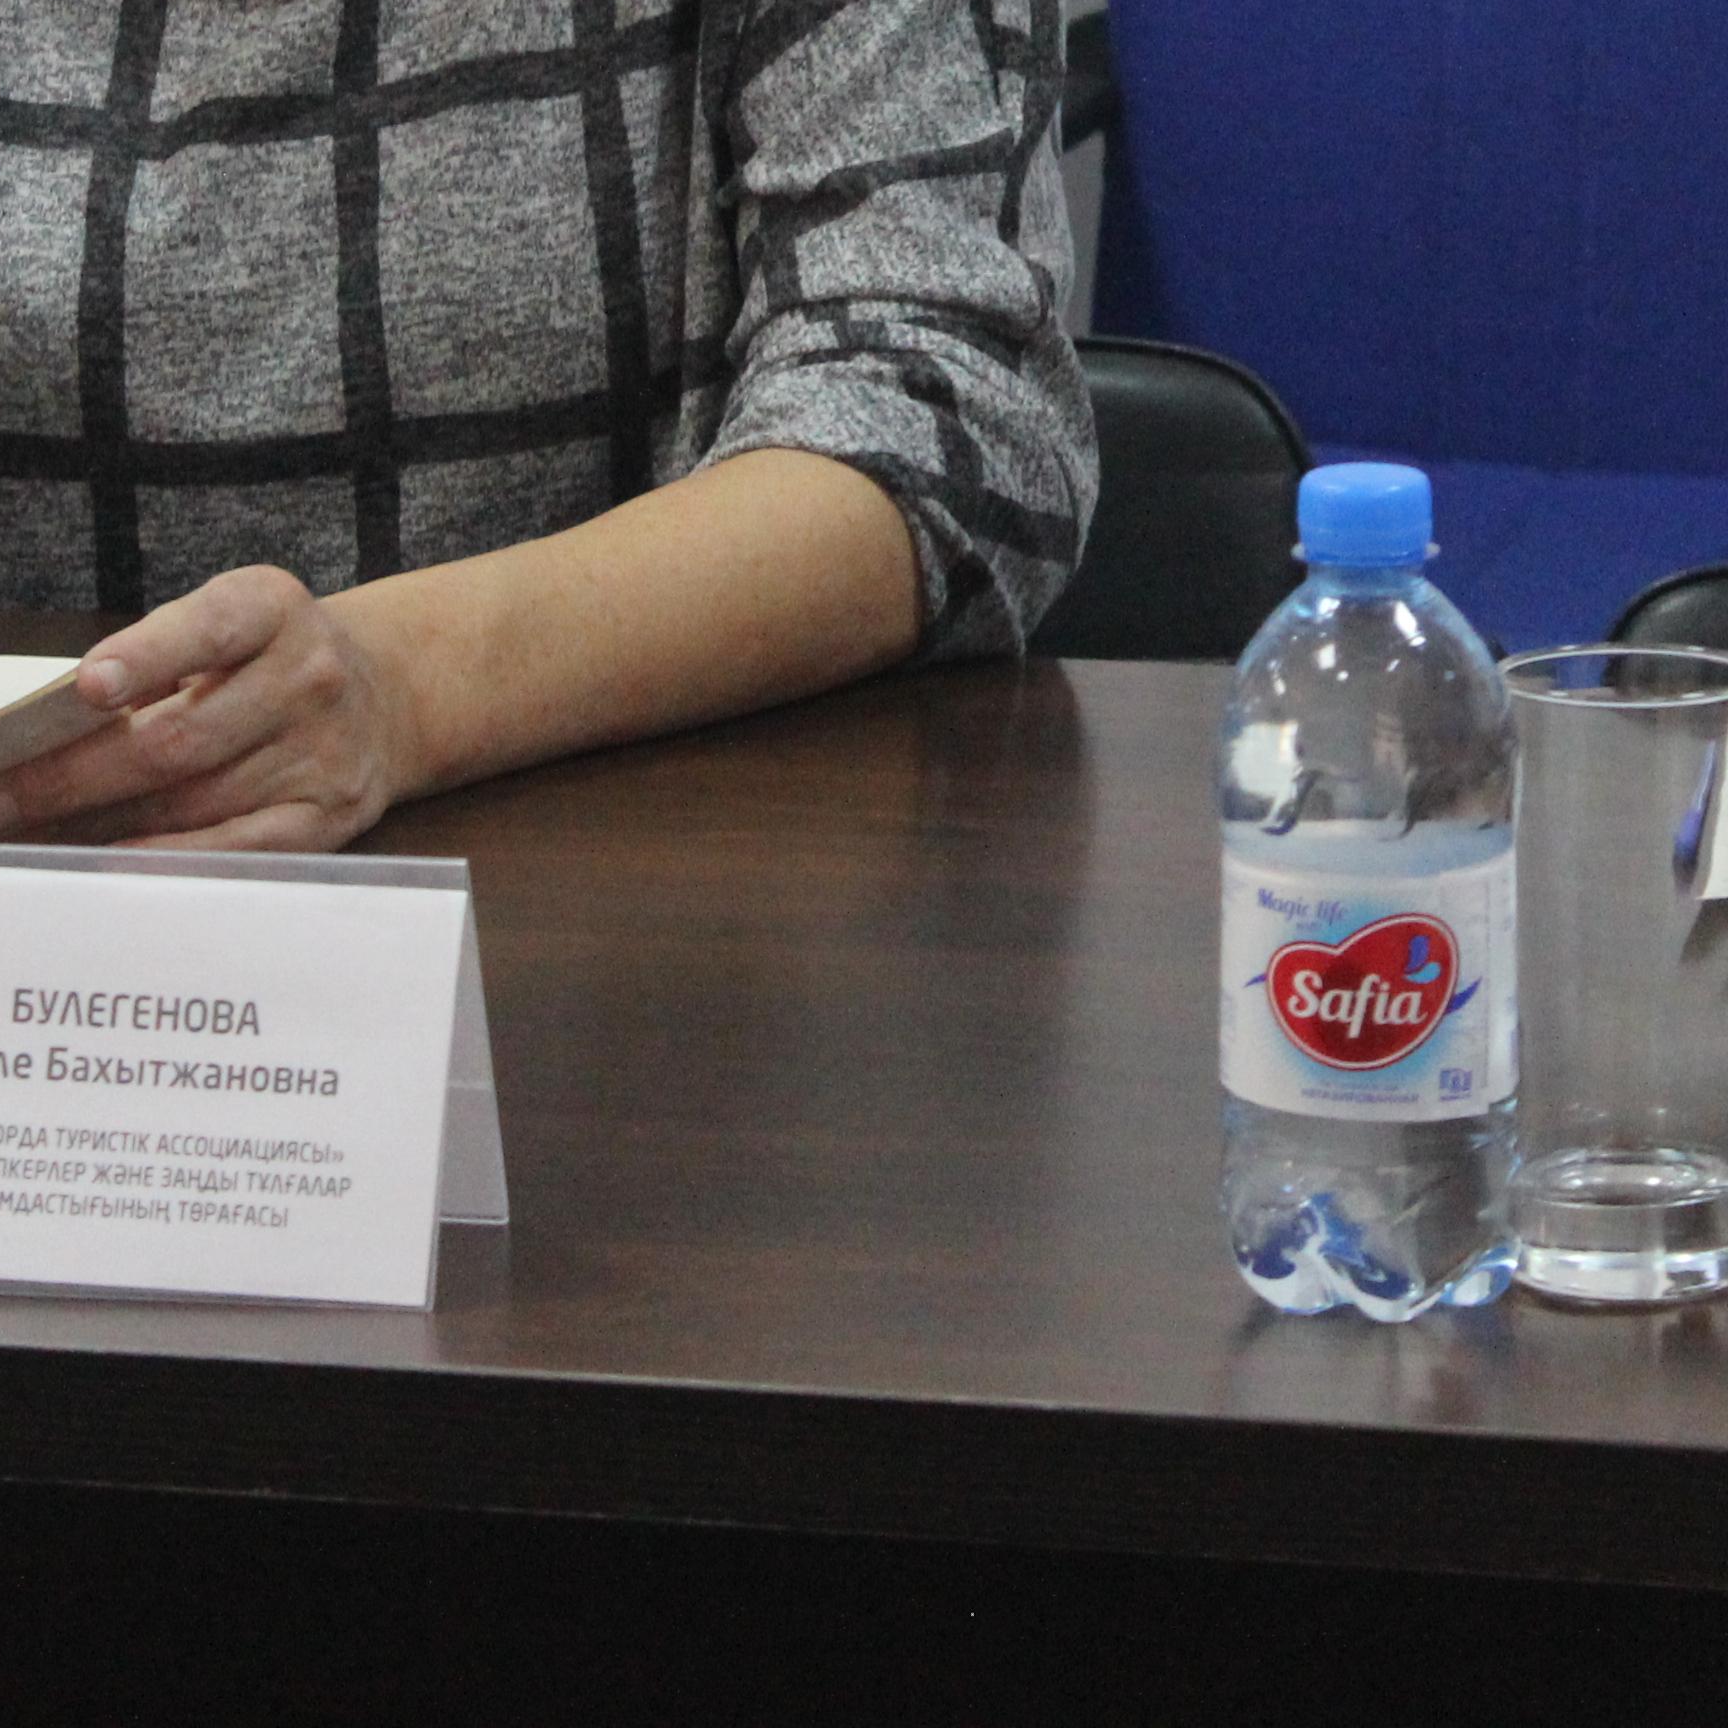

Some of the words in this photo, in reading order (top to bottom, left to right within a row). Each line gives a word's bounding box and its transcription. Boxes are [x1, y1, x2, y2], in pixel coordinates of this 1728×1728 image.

[11, 988, 261, 1037] БУЛЕГЕНОВА
[1287, 969, 1428, 1039] Safia
[46, 1046, 341, 1097] Бахытжановна
[92, 1161, 155, 1187] ЖӘНЕ
